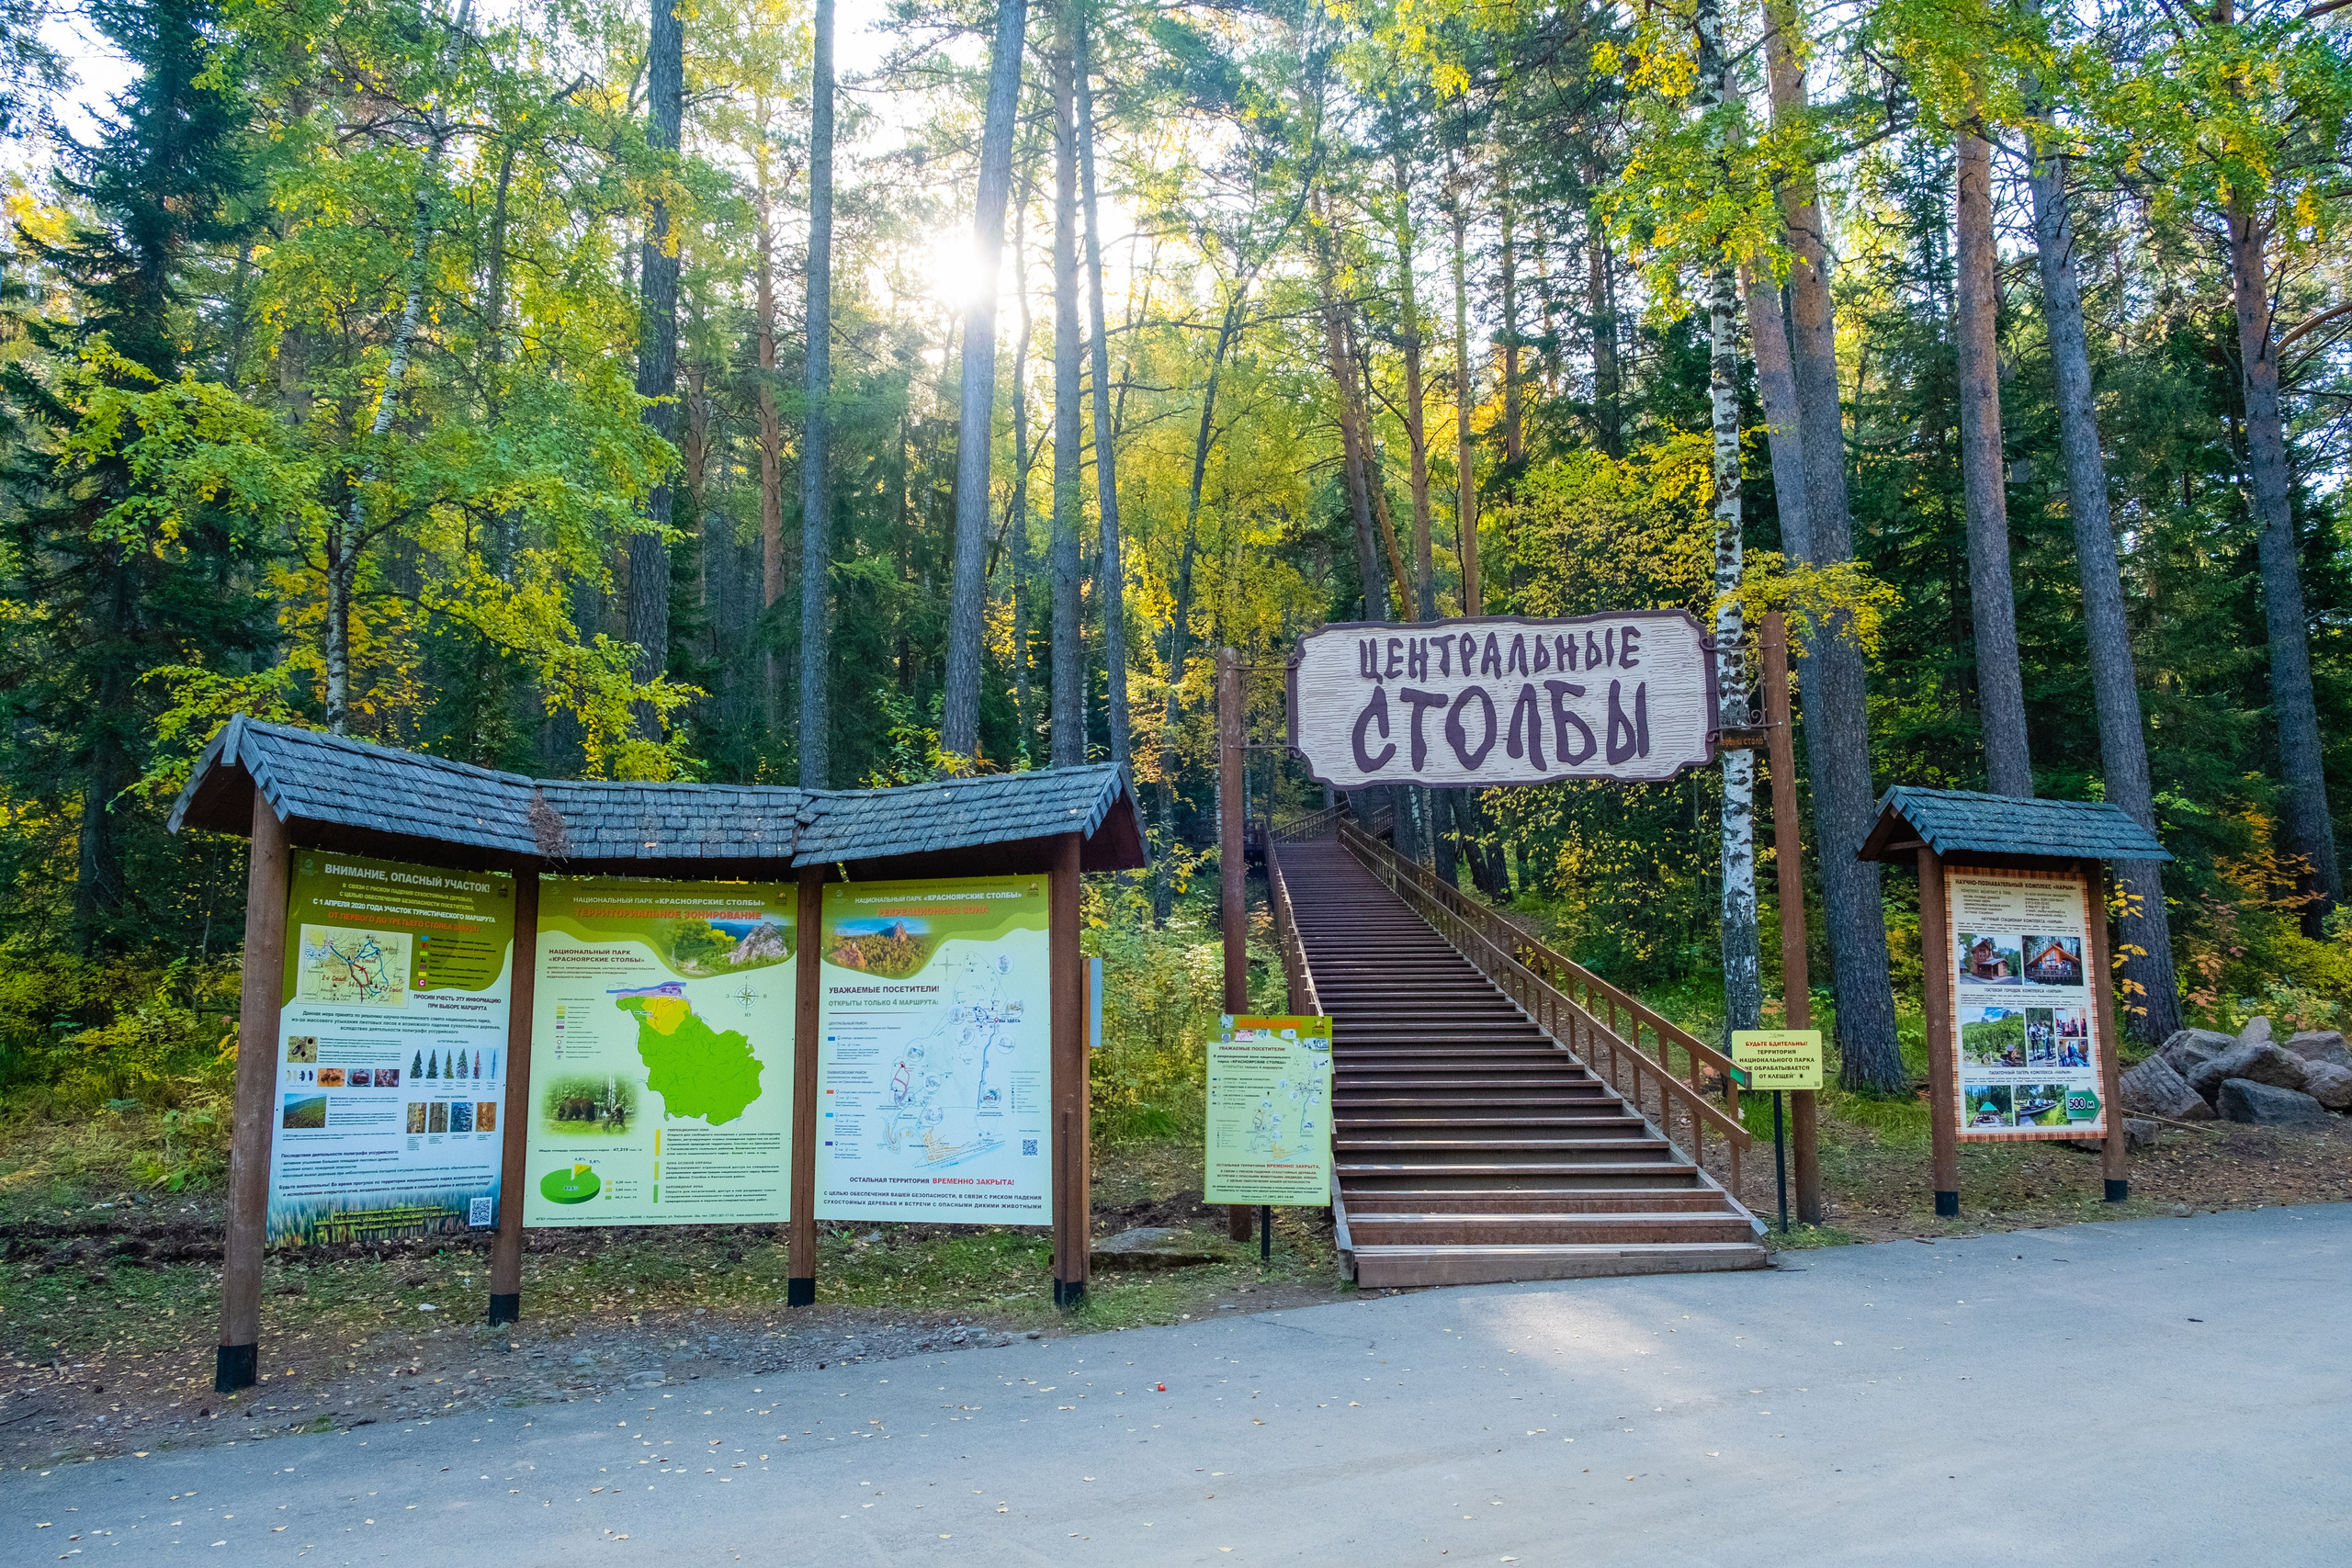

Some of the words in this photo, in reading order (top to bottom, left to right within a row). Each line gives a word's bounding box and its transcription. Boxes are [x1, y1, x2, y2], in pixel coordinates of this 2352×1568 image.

[1359, 626, 1641, 684] ЦЕНТРАЛЬНЫЕ
[1352, 679, 1650, 773] СТОЛБЫ
[1743, 736, 1764, 745] столб
[325, 864, 388, 881] ВНИМАНИЕ,
[390, 871, 441, 887] ОПАСНЫЙ
[444, 879, 490, 893] УЧАСТОК!
[1955, 878, 2023, 888] НАУЧНО-ПОЗНАВАТЕЛЬНЫЙ
[390, 888, 413, 896] ПАДЕНИЯ
[414, 890, 449, 900] СУХОСТОЙНЫХ
[448, 895, 474, 903] ДЕРЕВЬЕВ,
[573, 896, 633, 905] НАЦИОНАЛЬНЫЙ
[855, 895, 905, 904] НАЦИОНАЛЬНЫЙ
[923, 893, 984, 902] «КРАСНОЯРСКИЕ
[985, 892, 1022, 900] СТОЛБЫ»
[364, 894, 401, 903] ОБЕСПЕЧЕНИЯ
[401, 898, 440, 907] БЕЗОПАСНОСТИ
[440, 901, 475, 911] ПОСЕТИТЕЛЕЙ,
[323, 899, 350, 908] АПРЕЛЯ
[366, 904, 383, 912] ГОДА
[383, 905, 412, 915] УЧАСТОК
[412, 908, 464, 920] ТУРИСТИЧЕСКОГО
[464, 913, 496, 923] МАРШРУТА
[574, 908, 681, 919] ТЕРРИТОРИАЛЬНОЕ
[683, 910, 762, 920] ЗОНИРОВАНИЕ
[877, 906, 959, 917] РЕКРЕАЦИОННАЯ
[962, 906, 988, 915] ЗОНА
[340, 913, 375, 923] ПЕРВОГО
[388, 917, 424, 928] ТРЕТЬЕГО
[424, 920, 453, 930] СТОЛБА
[2068, 1098, 2085, 1108] 500
